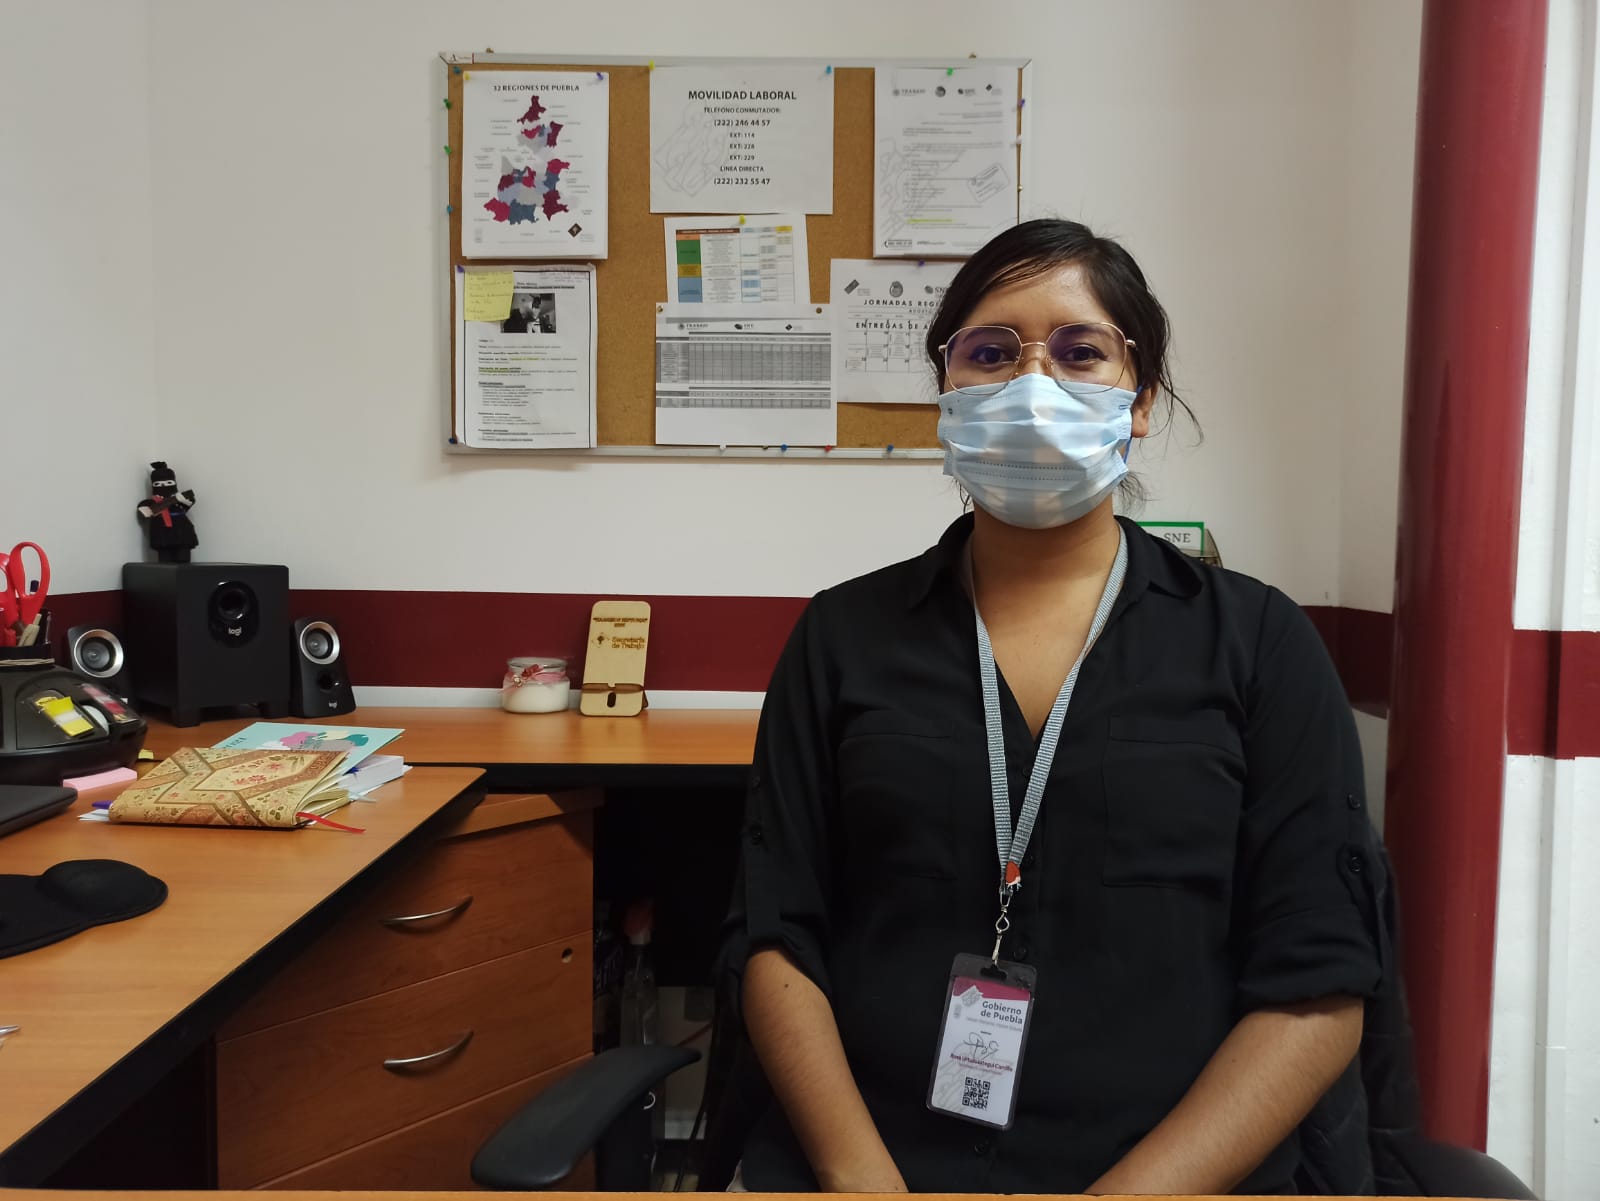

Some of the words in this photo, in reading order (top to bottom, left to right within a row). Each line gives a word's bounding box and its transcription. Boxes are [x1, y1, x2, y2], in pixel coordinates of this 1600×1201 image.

[688, 90, 748, 100] MOVILIDAD
[749, 90, 797, 100] LABORAL
[713, 119, 734, 127] (222)
[863, 299, 913, 307] JORNADAS
[1163, 532, 1192, 543] SNE
[982, 1000, 1022, 1015] Gobierno
[980, 1009, 992, 1018] de
[993, 1011, 1023, 1025] Puebla
